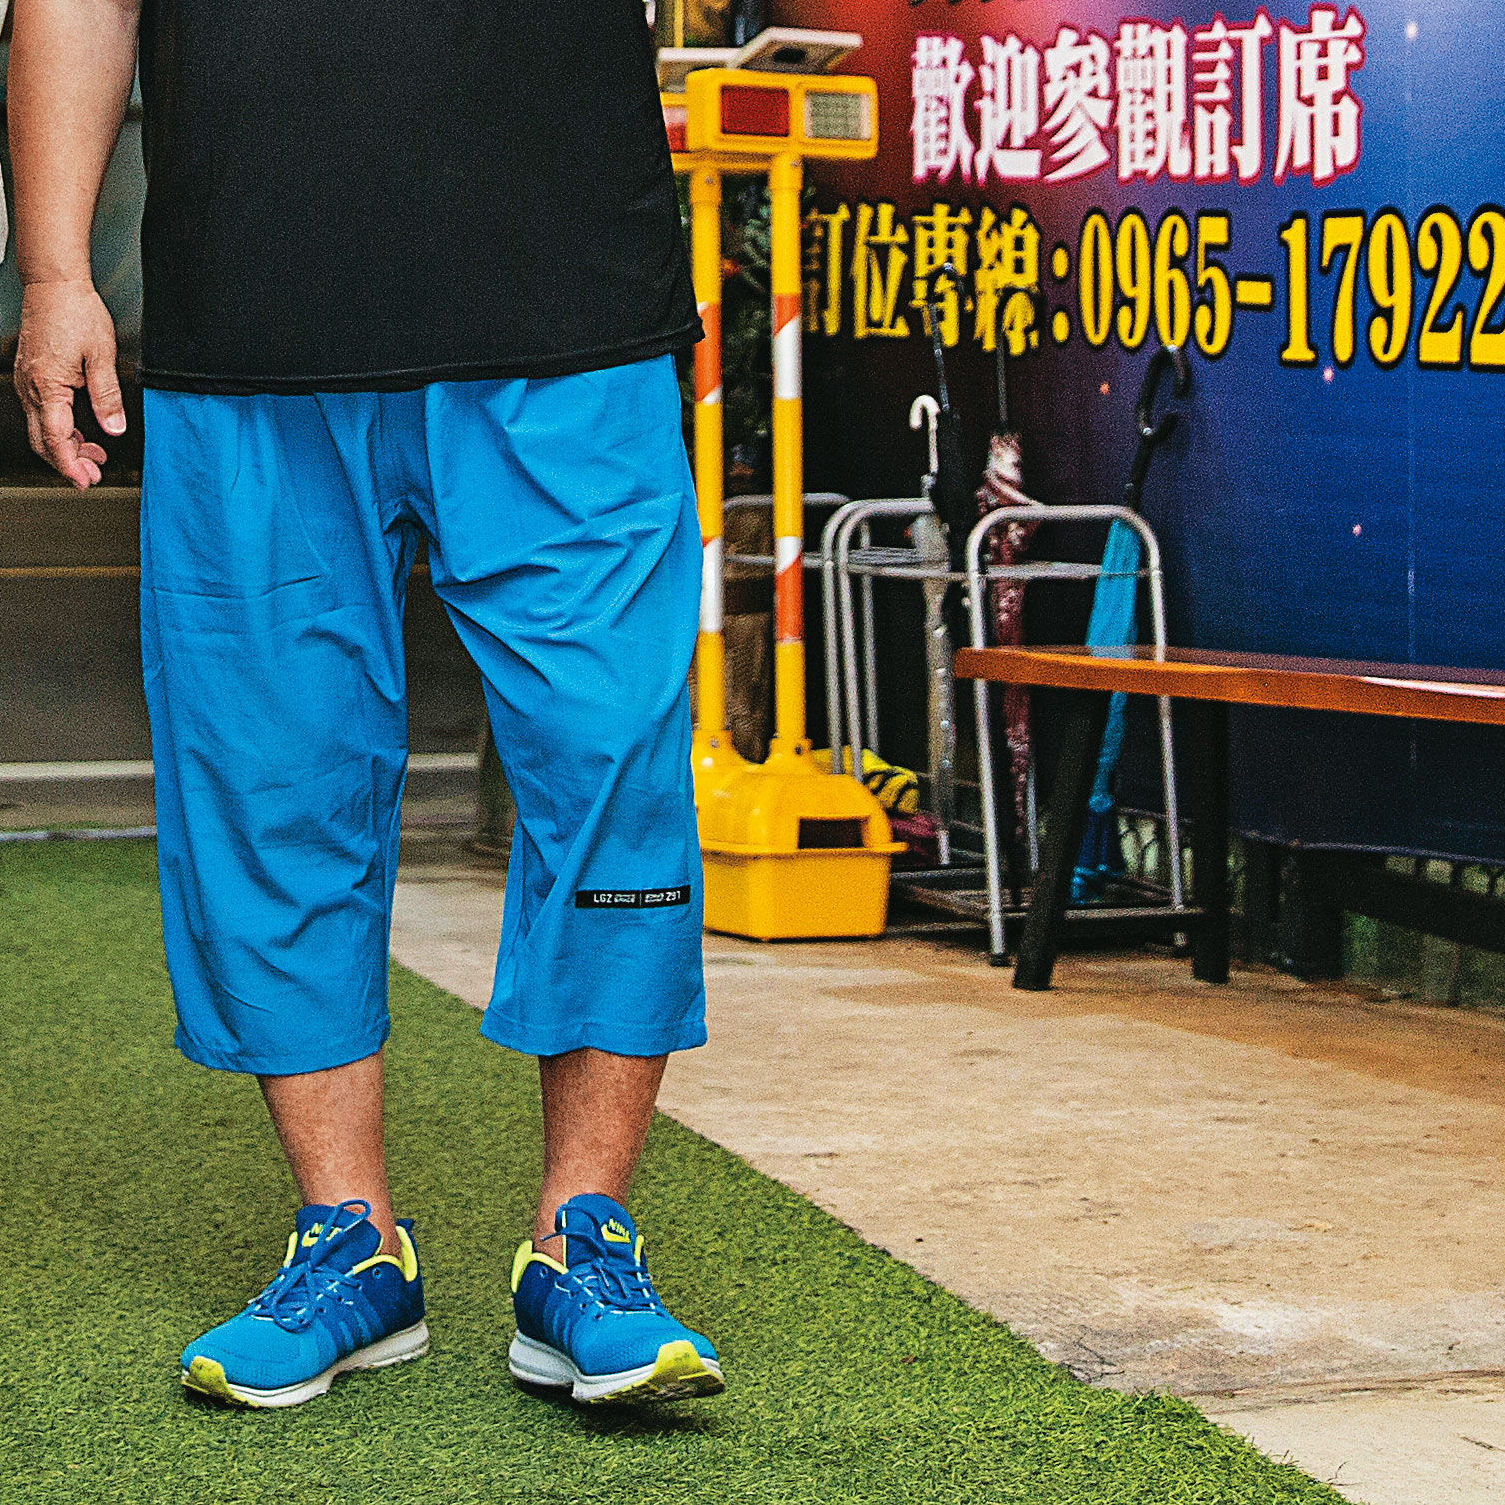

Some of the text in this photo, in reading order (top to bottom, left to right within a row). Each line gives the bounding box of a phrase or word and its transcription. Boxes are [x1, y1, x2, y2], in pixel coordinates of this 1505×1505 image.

[910, 5, 1365, 183] 歡迎參觀訂席
